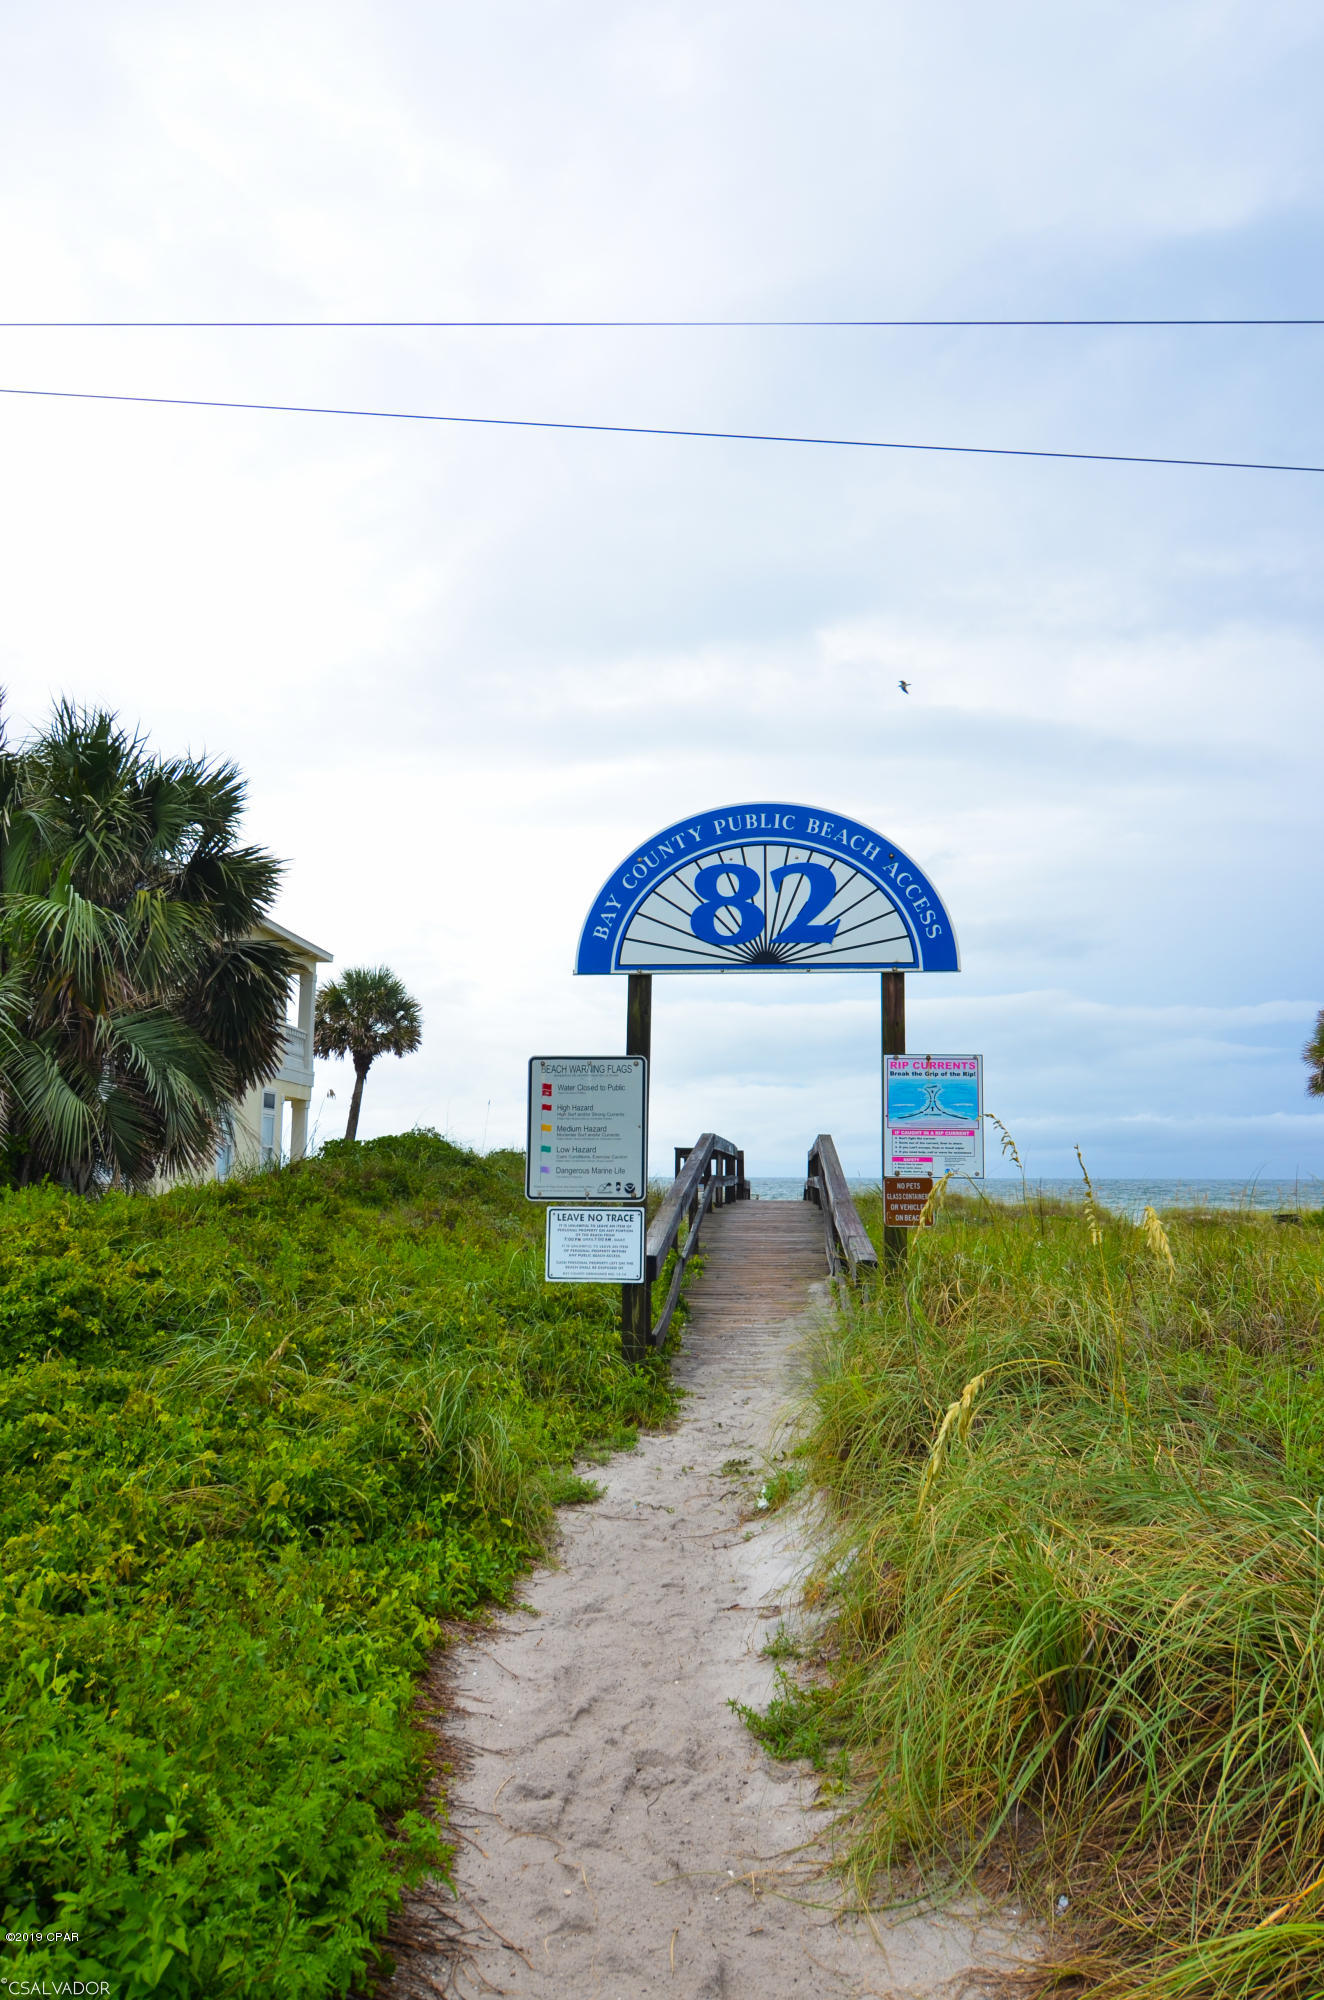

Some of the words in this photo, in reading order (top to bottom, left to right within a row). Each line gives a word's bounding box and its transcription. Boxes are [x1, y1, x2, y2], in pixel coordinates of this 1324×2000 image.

[592, 892, 623, 941] BAY
[621, 825, 703, 890] COUNTY
[713, 813, 797, 835] PUBLIC
[806, 817, 878, 863] BEACH
[881, 860, 943, 940] ACCESS
[690, 861, 841, 946] 82
[541, 1064, 567, 1074] BEACH
[568, 1064, 605, 1074] WARNING
[607, 1064, 633, 1074] FLAGS
[889, 1061, 909, 1070] RIP
[912, 1061, 976, 1070] CURRENTS
[557, 1083, 575, 1092] Water
[577, 1083, 598, 1092] Closed
[600, 1083, 606, 1092] to
[607, 1083, 626, 1092] Public
[556, 1104, 570, 1112] High
[556, 1124, 581, 1132] Medium
[583, 1124, 607, 1132] Hazard
[555, 1166, 590, 1175] Dangerous
[591, 1166, 613, 1174] Marine
[896, 1182, 905, 1190] NO
[905, 1182, 921, 1190] PETS
[557, 1213, 585, 1222] LEAVE
[588, 1213, 603, 1222] NO
[606, 1213, 634, 1222] TRACE
[895, 1214, 904, 1222] ON
